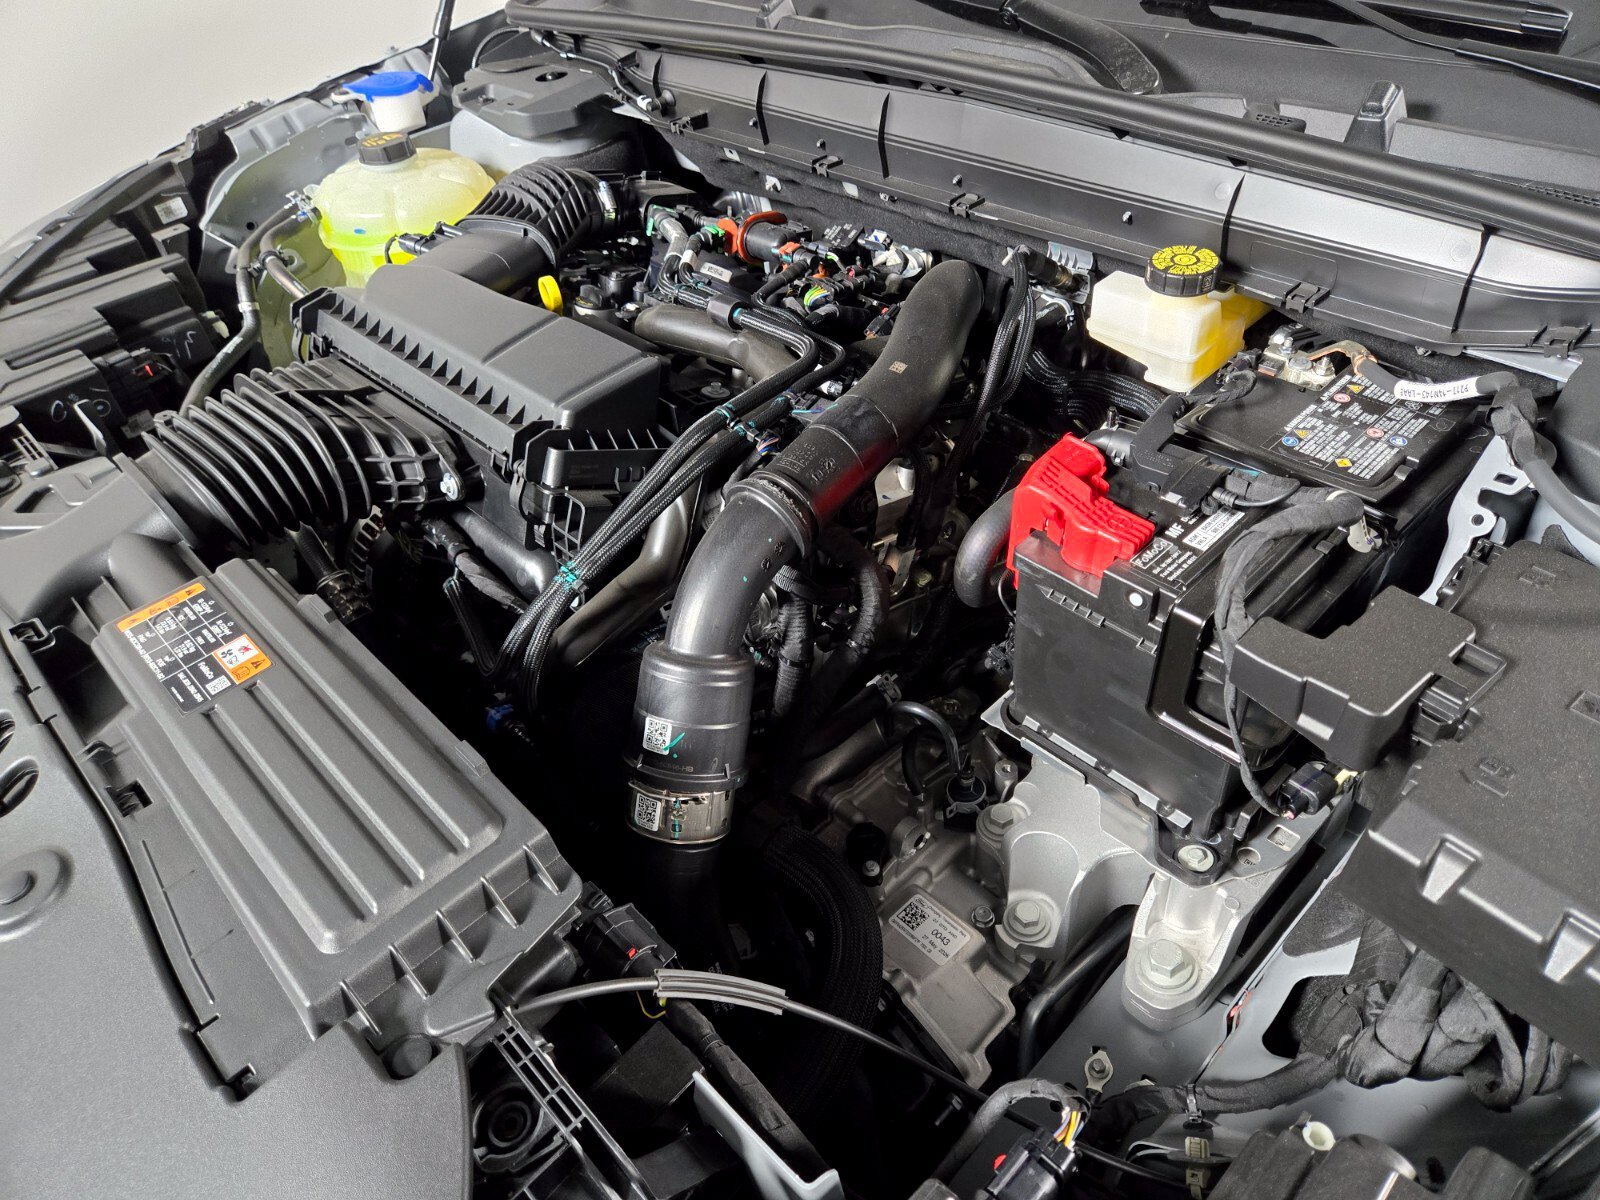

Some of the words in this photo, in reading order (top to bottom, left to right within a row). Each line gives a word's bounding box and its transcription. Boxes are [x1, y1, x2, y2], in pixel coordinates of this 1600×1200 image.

[1165, 523, 1184, 538] MF
[1135, 540, 1168, 566] FoMoCo
[198, 661, 216, 680] FoMoCo
[929, 940, 937, 949] May
[931, 928, 950, 946] 0043
